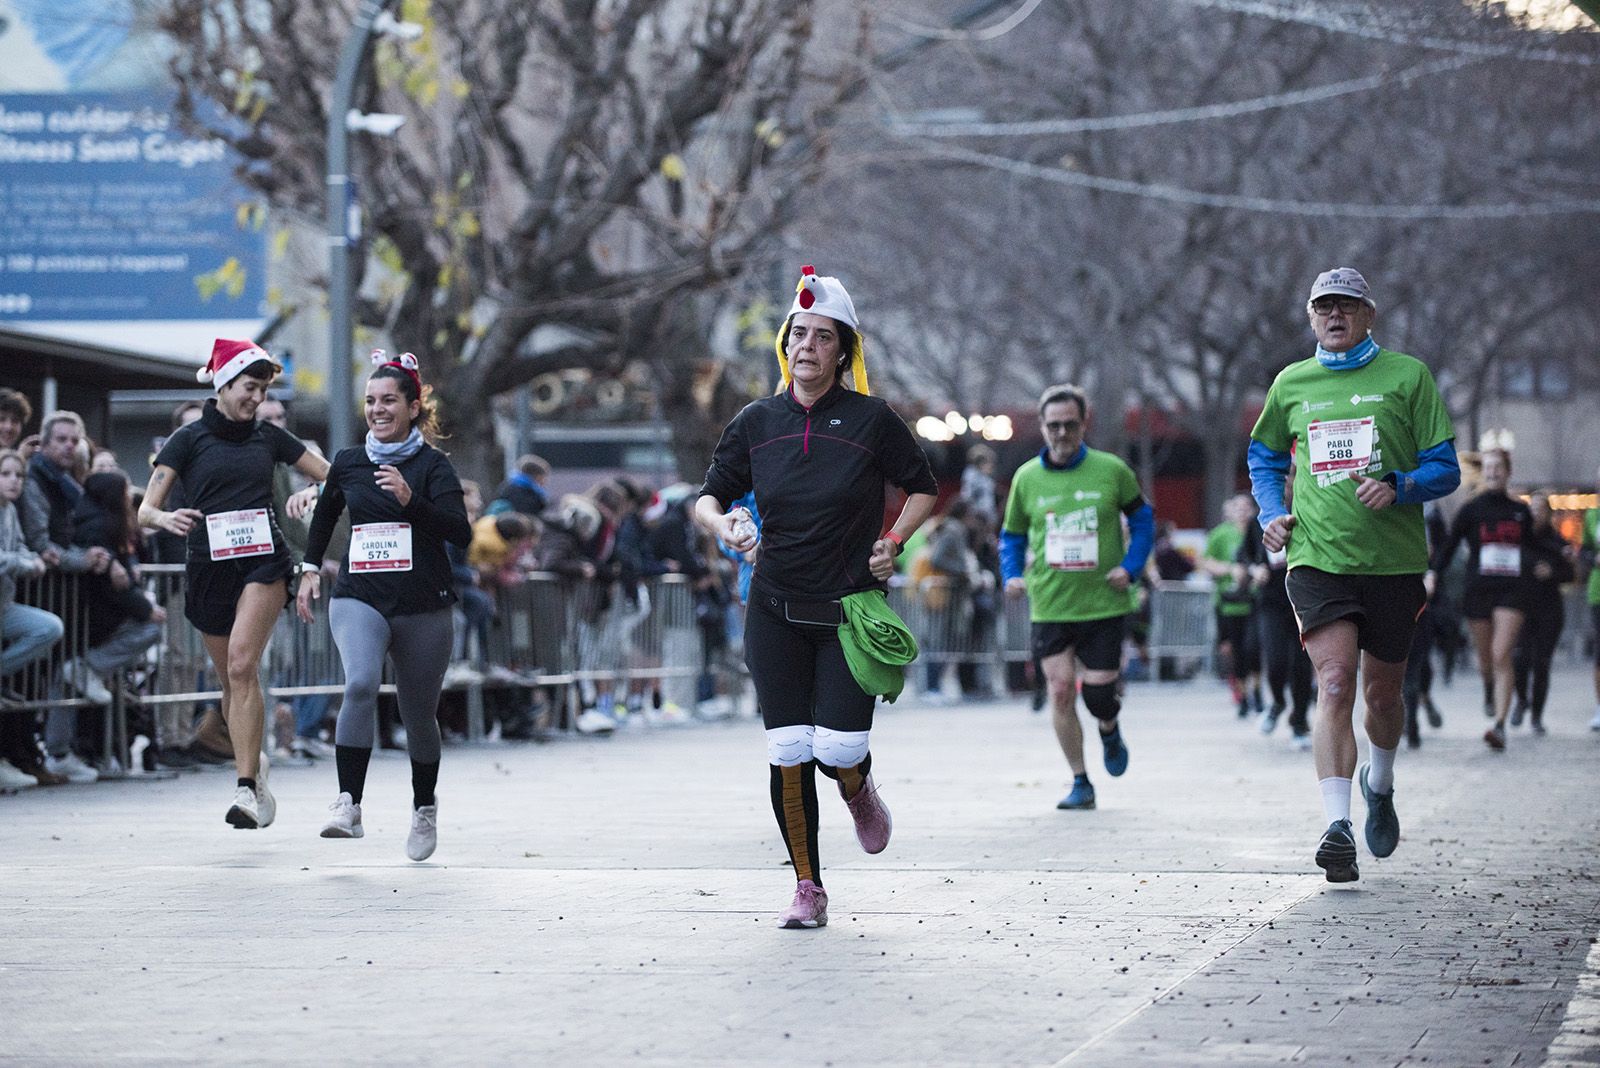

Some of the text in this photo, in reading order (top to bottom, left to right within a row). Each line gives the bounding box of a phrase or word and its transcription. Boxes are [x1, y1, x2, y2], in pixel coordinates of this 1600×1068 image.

[1327, 439, 1353, 449] PABLO
[1329, 449, 1353, 460] 588
[225, 527, 255, 537] ANDREA
[231, 536, 253, 546] 582
[361, 540, 398, 550] CAROLINA
[368, 550, 390, 560] 575
